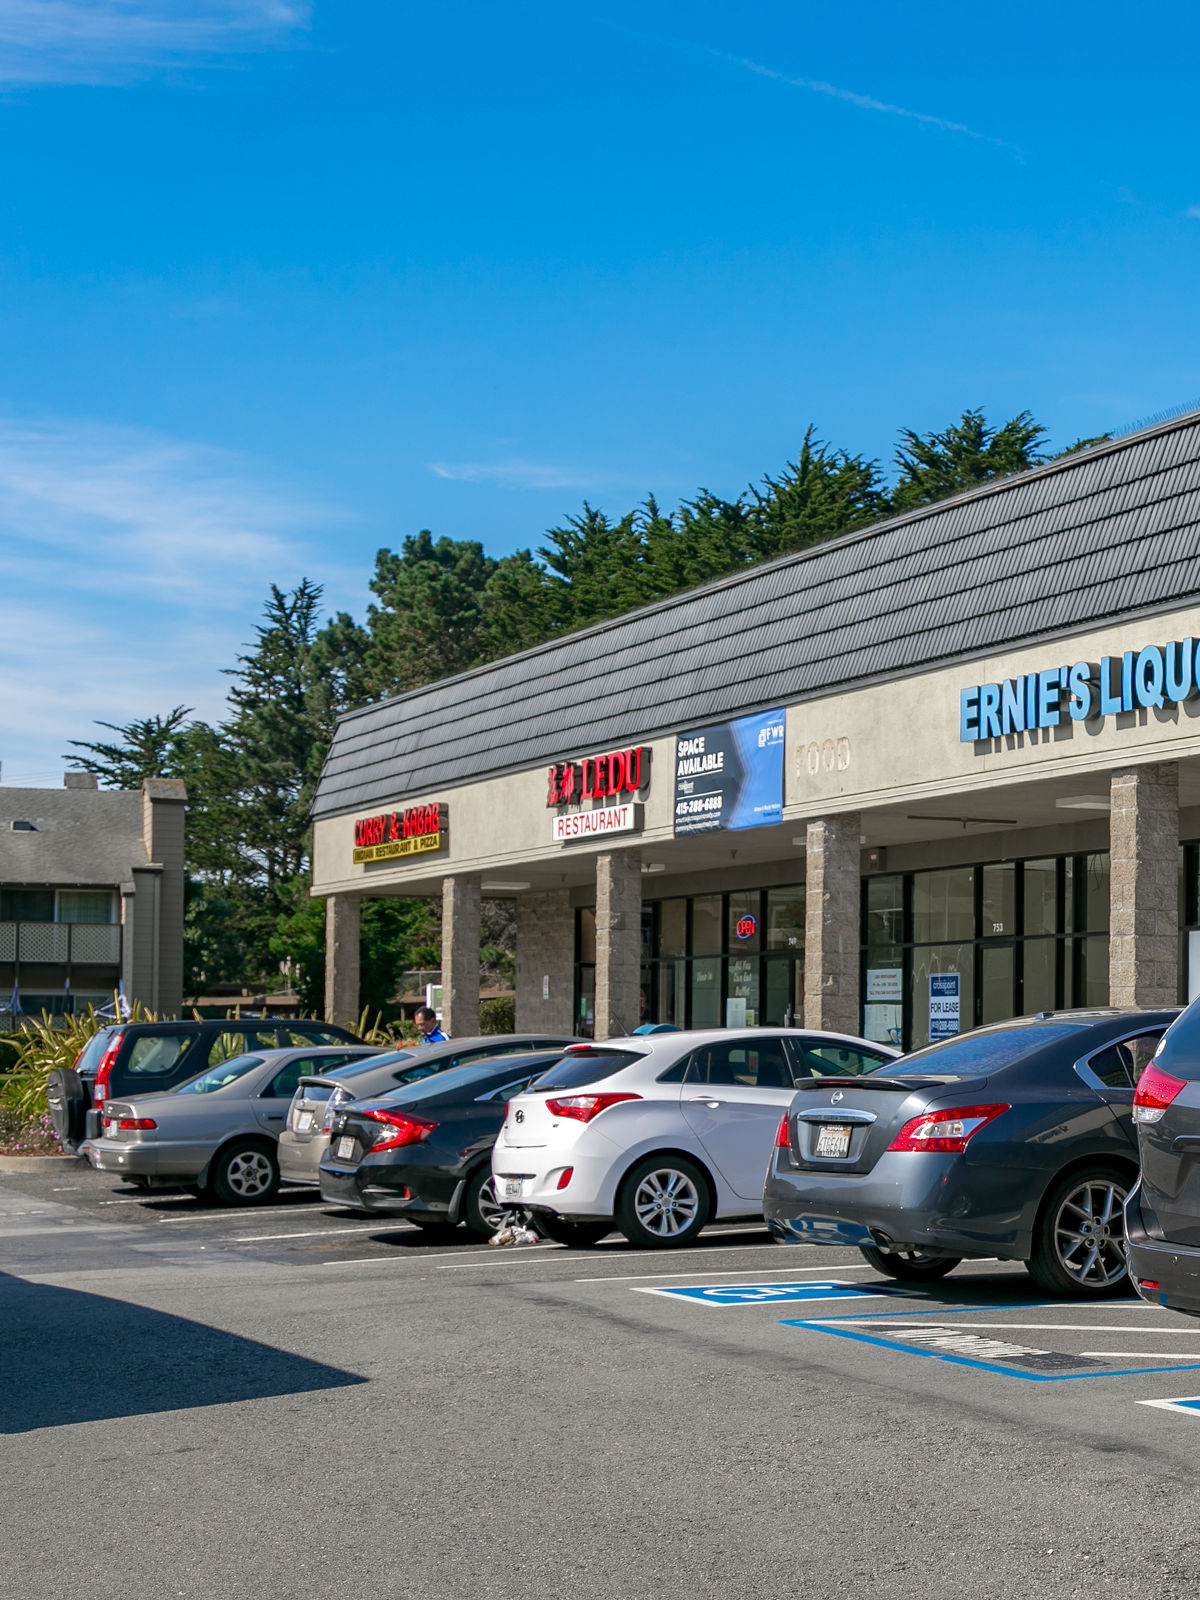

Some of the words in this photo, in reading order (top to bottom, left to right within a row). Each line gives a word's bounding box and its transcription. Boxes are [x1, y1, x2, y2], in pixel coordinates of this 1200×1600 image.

[960, 661, 1091, 742] ERNIE'S
[678, 736, 705, 757] SPACE
[581, 747, 642, 800] LEDU
[677, 752, 724, 776] AVAILABLE
[354, 814, 386, 847] CURRY
[388, 811, 399, 840] &
[402, 802, 440, 838] KABAB
[557, 807, 628, 837] RESTAURANT
[375, 841, 411, 858] RESTAURANT
[420, 835, 438, 848] PIZZA
[736, 920, 755, 935] OPEN
[992, 923, 1003, 932] 753
[931, 1002, 941, 1013] FOR
[943, 1002, 959, 1013] LEASE
